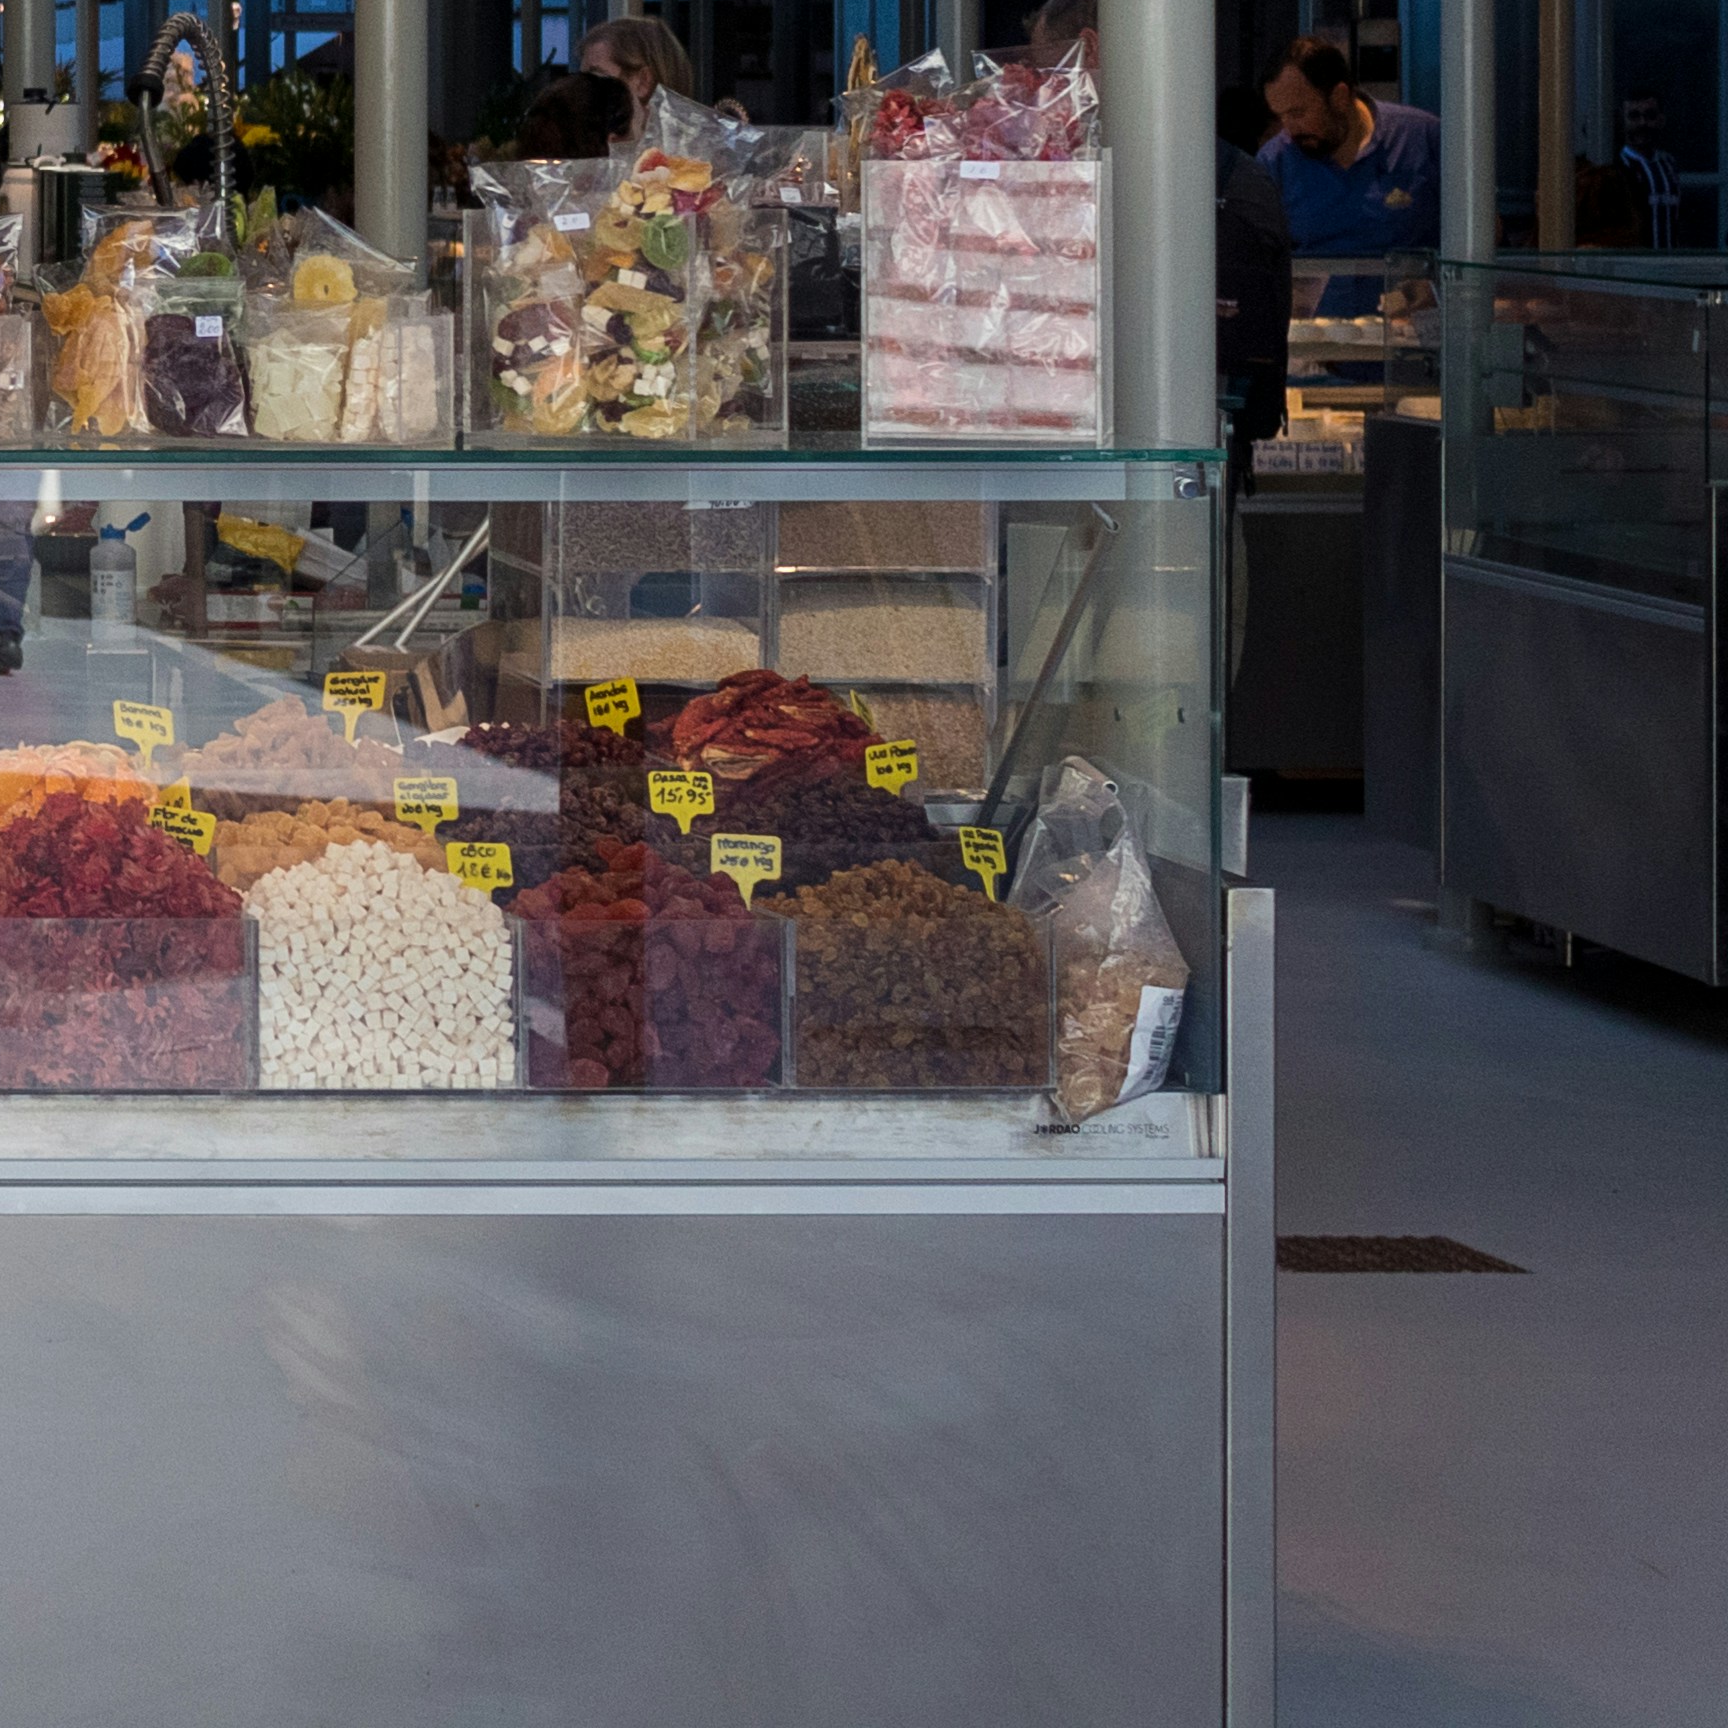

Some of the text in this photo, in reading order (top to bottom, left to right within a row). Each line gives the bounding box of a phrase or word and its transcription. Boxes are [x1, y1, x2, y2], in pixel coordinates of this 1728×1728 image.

[119, 702, 163, 720] Banana
[180, 813, 198, 826] de
[716, 838, 777, 854] Morango
